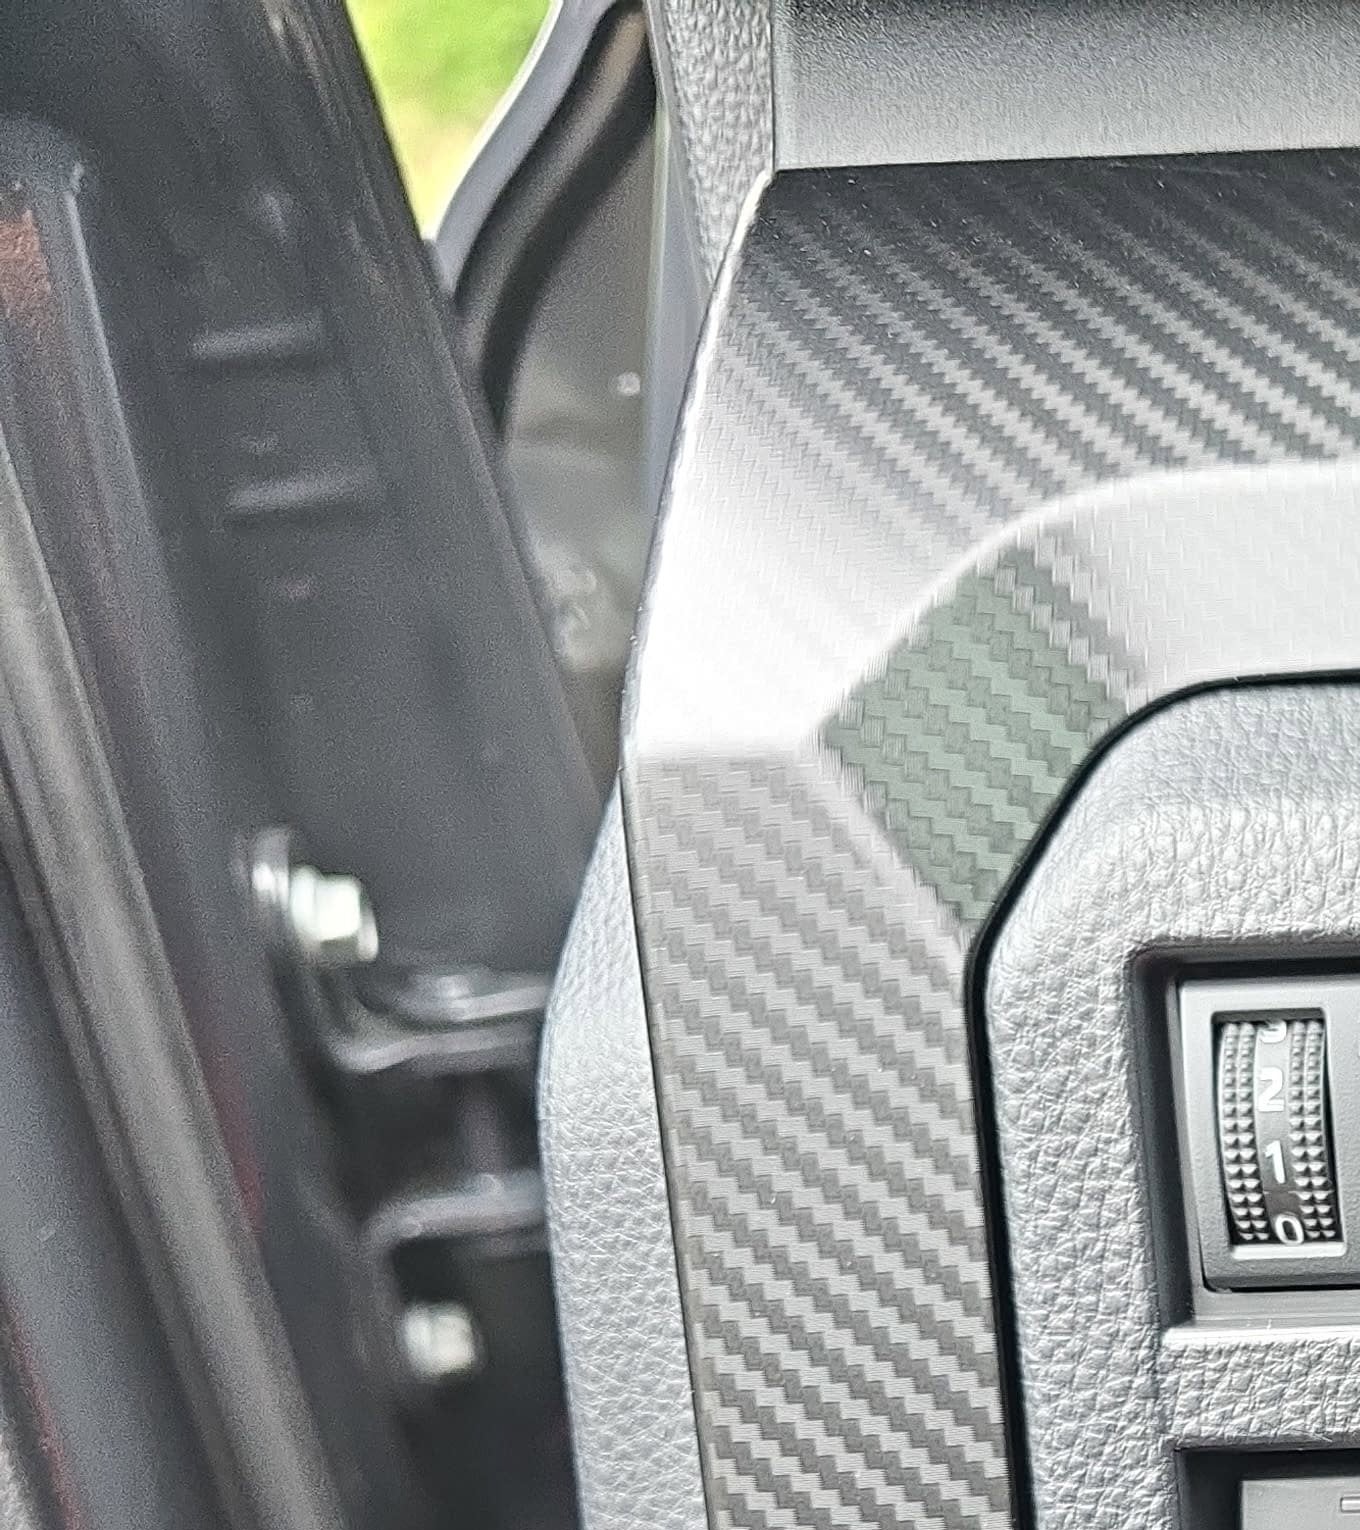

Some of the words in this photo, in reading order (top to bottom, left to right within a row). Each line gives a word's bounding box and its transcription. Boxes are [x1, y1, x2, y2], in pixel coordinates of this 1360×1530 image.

[1258, 1066, 1285, 1112] 2
[1265, 1139, 1286, 1184] 1
[1274, 1213, 1305, 1245] 0
